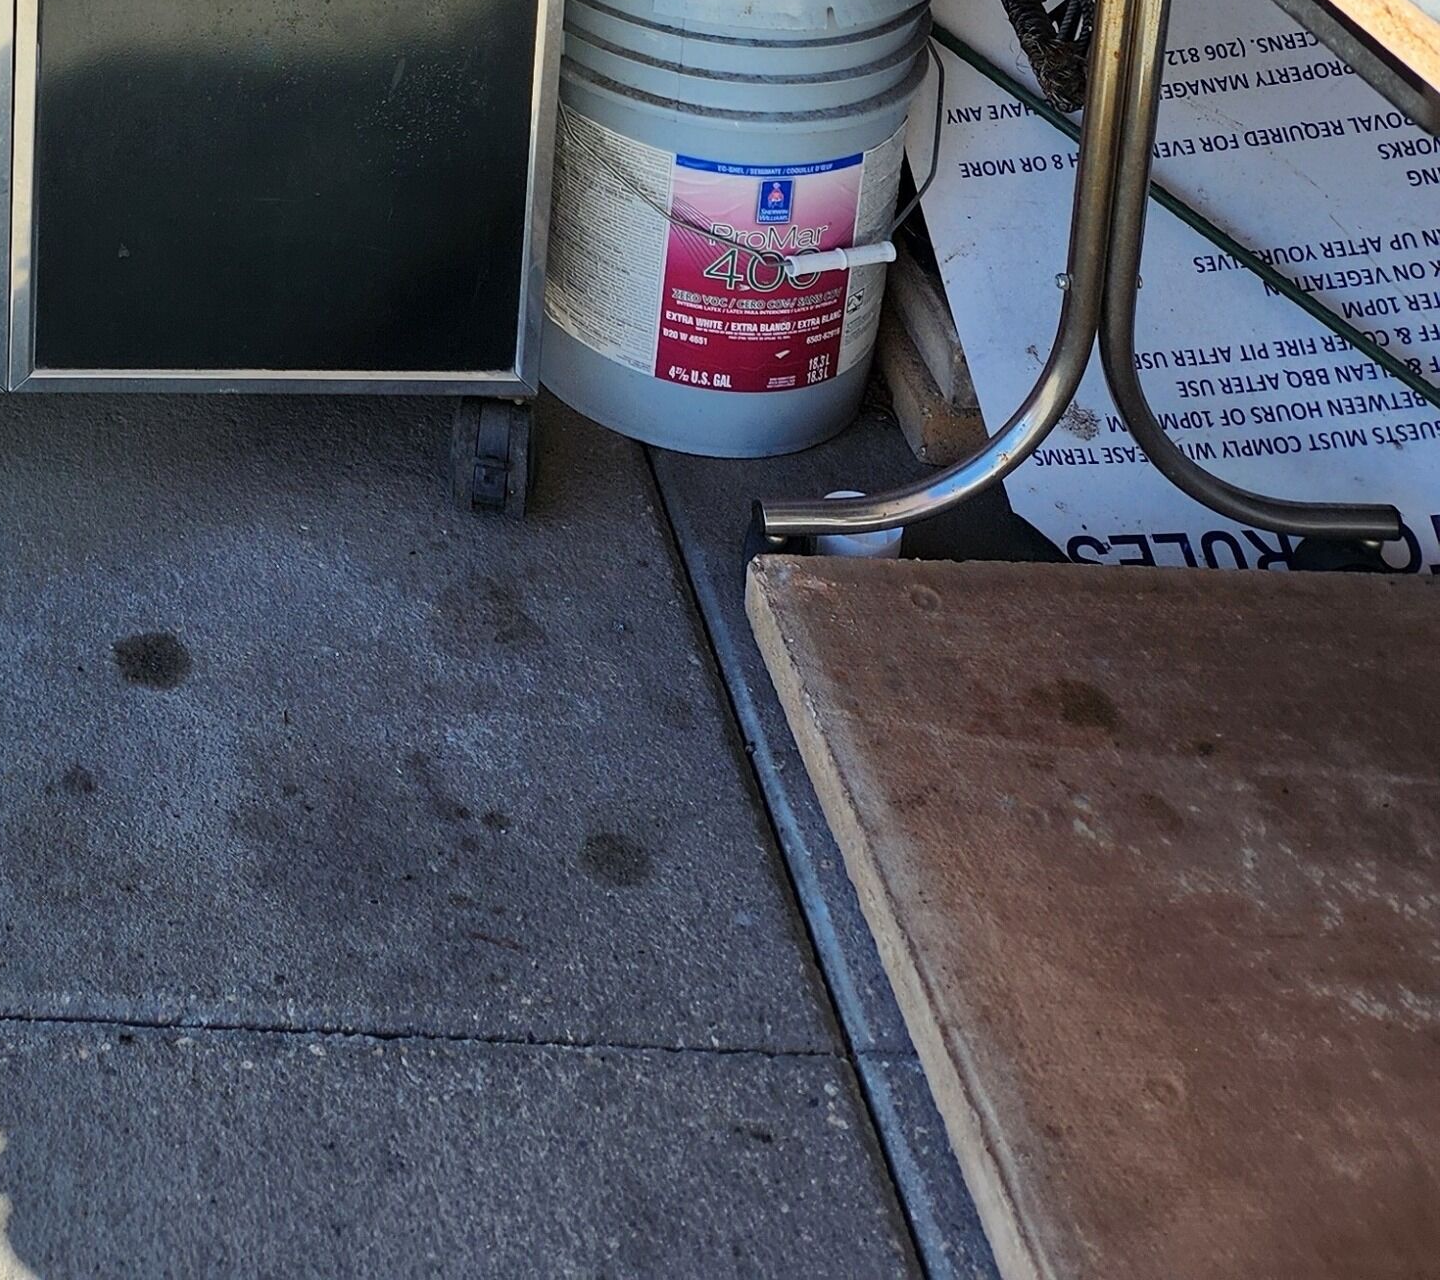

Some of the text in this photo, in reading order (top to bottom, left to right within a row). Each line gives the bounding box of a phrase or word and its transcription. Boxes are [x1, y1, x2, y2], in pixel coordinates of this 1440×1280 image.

[1165, 30, 1320, 66] CERNS. (206 812
[946, 59, 1356, 125] PROPERTY MANAGE HAVE ANY
[1201, 133, 1240, 151] FOR
[1243, 119, 1345, 146] REQUIRED
[1152, 138, 1196, 159] EVEN
[958, 158, 1016, 178] MORE
[1020, 155, 1047, 173] OR
[1051, 153, 1064, 170] 8
[709, 223, 828, 250] ProMar
[1319, 235, 1382, 259] AFTER
[1389, 232, 1419, 251] UP
[703, 246, 821, 293] 400
[1392, 261, 1426, 282] ON
[1262, 266, 1392, 297] VEGETATIN
[671, 287, 701, 305] ZERO
[702, 292, 728, 307] VOC
[736, 297, 765, 310] CERO
[1341, 291, 1440, 320] TER 10PM
[665, 310, 694, 326] EXTRA
[695, 316, 723, 331] WHITE
[730, 321, 758, 332] EXTRA
[759, 320, 791, 332] BLANCO
[797, 316, 821, 330] EXTRA
[820, 309, 842, 325] BLANC
[1135, 323, 1440, 371] FF & COER FIRE PIT AFTER USE
[690, 370, 711, 386] U.S.
[712, 373, 732, 389] GAL
[1221, 373, 1280, 395] AFTER
[1283, 367, 1330, 388] BBQ
[1336, 361, 1389, 386] LEAN
[1175, 378, 1216, 398] USE
[1250, 401, 1323, 425] HOURS
[1327, 389, 1428, 417] BETWEEN
[1219, 407, 1246, 427] OF
[1222, 435, 1303, 459] COMPLY
[1308, 429, 1367, 451] MUST
[1031, 446, 1100, 467] TERMS
[1103, 446, 1150, 465] EASE
